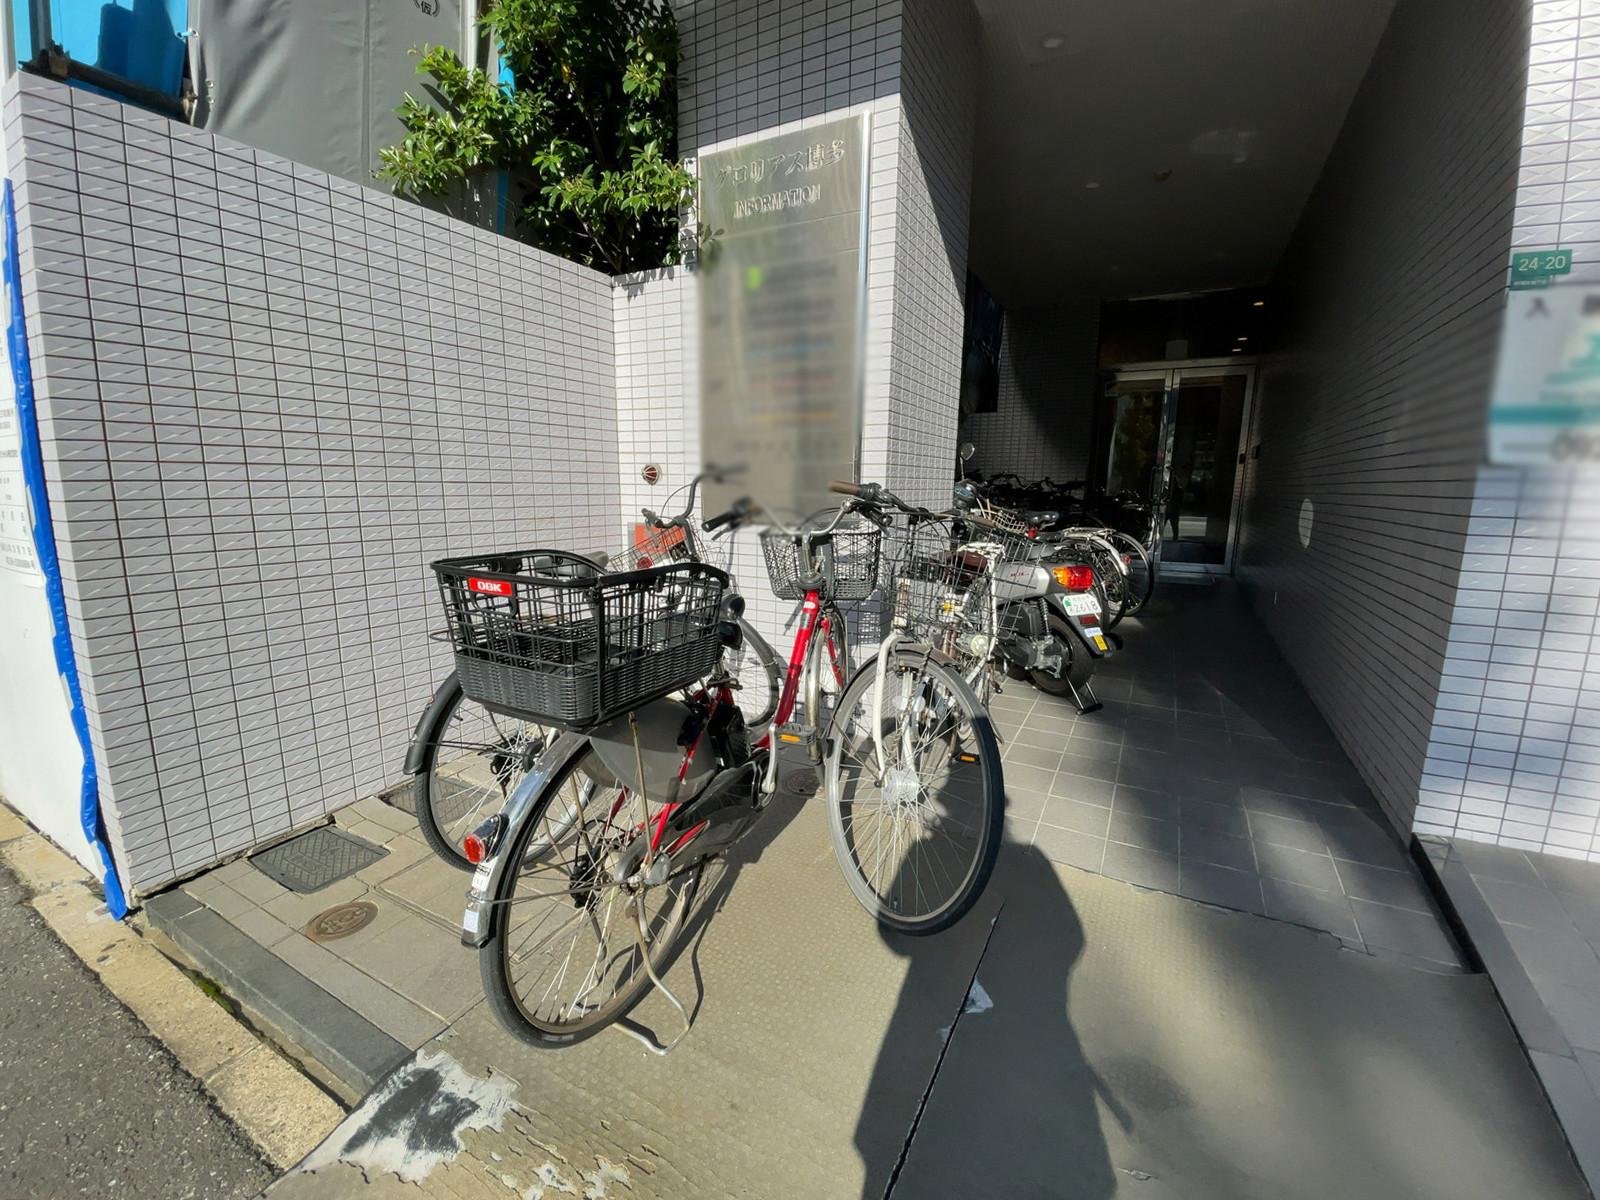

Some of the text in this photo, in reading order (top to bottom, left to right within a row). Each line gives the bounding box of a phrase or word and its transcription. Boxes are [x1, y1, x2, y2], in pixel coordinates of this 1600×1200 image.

[715, 138, 846, 190] グロリアス博多
[733, 183, 821, 219] INFORMATION
[1518, 255, 1567, 272] 24-20
[477, 581, 502, 592] OGK
